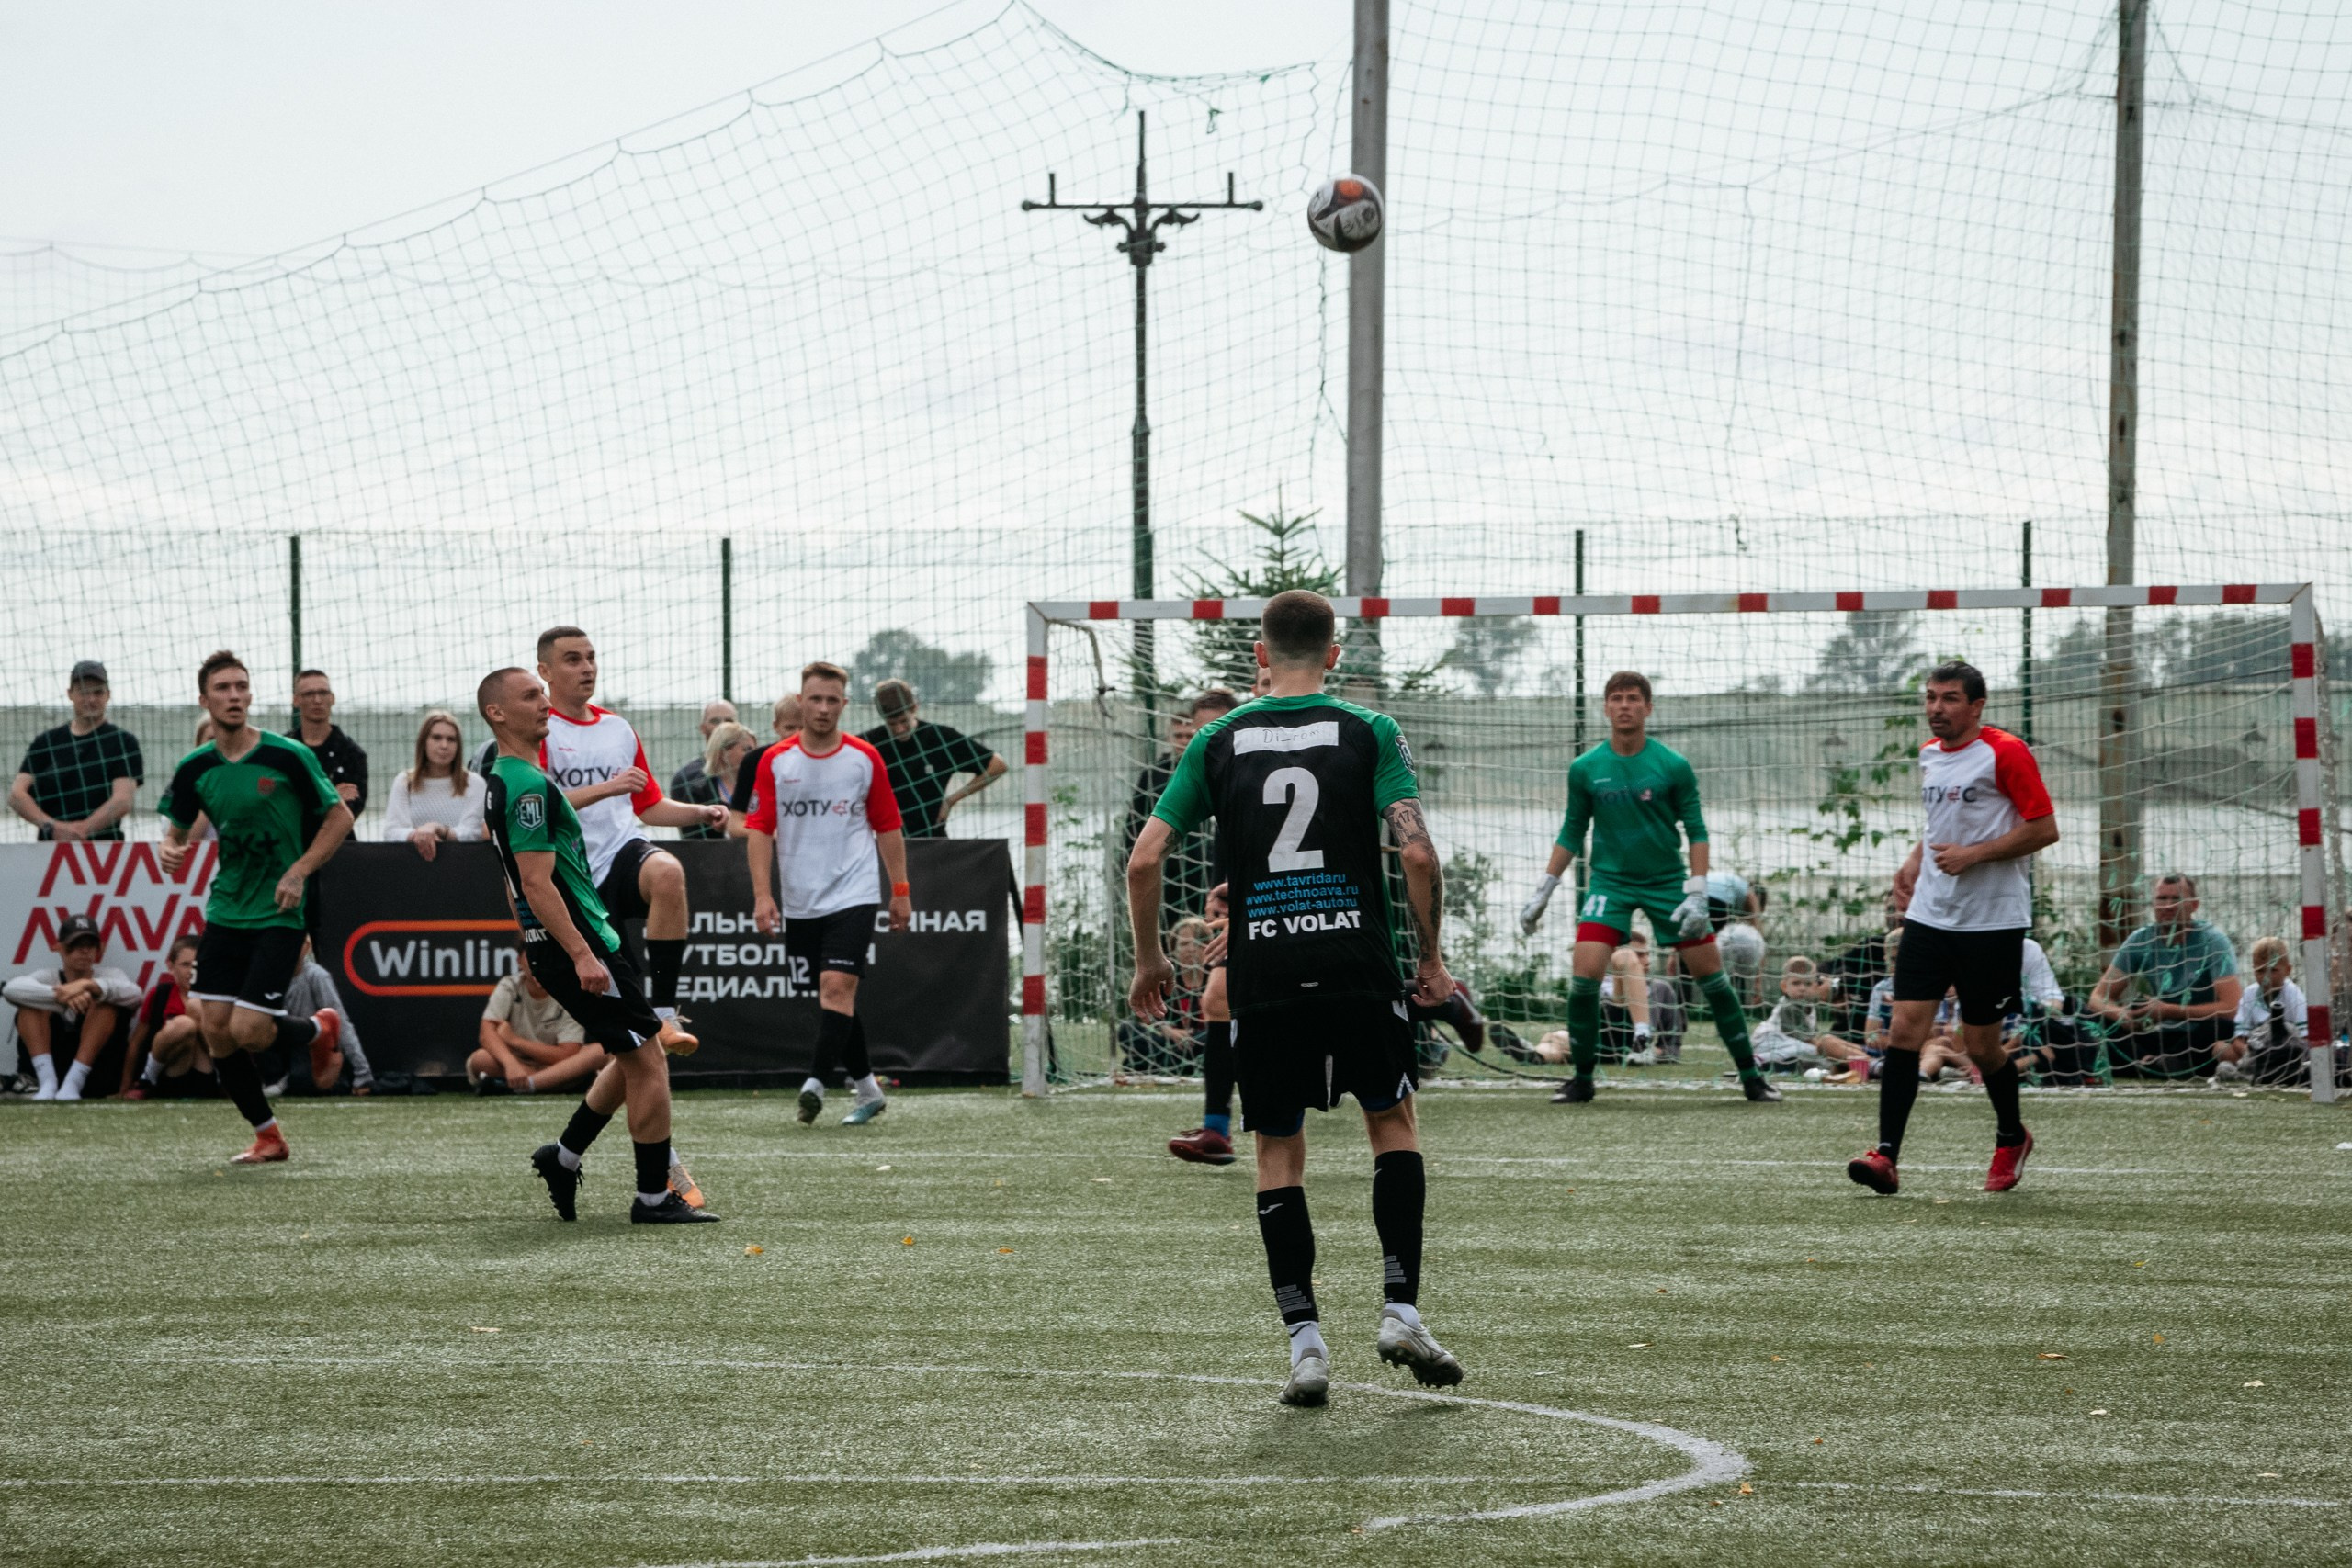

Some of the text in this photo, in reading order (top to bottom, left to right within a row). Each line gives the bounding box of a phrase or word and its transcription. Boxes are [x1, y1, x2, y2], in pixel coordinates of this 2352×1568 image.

[1262, 767, 1324, 873] 2
[1398, 808, 1411, 824] 17
[1582, 894, 1608, 918] 41
[1249, 910, 1361, 940] FC VOLAT
[369, 939, 519, 978] Winlin
[788, 956, 811, 985] 12
